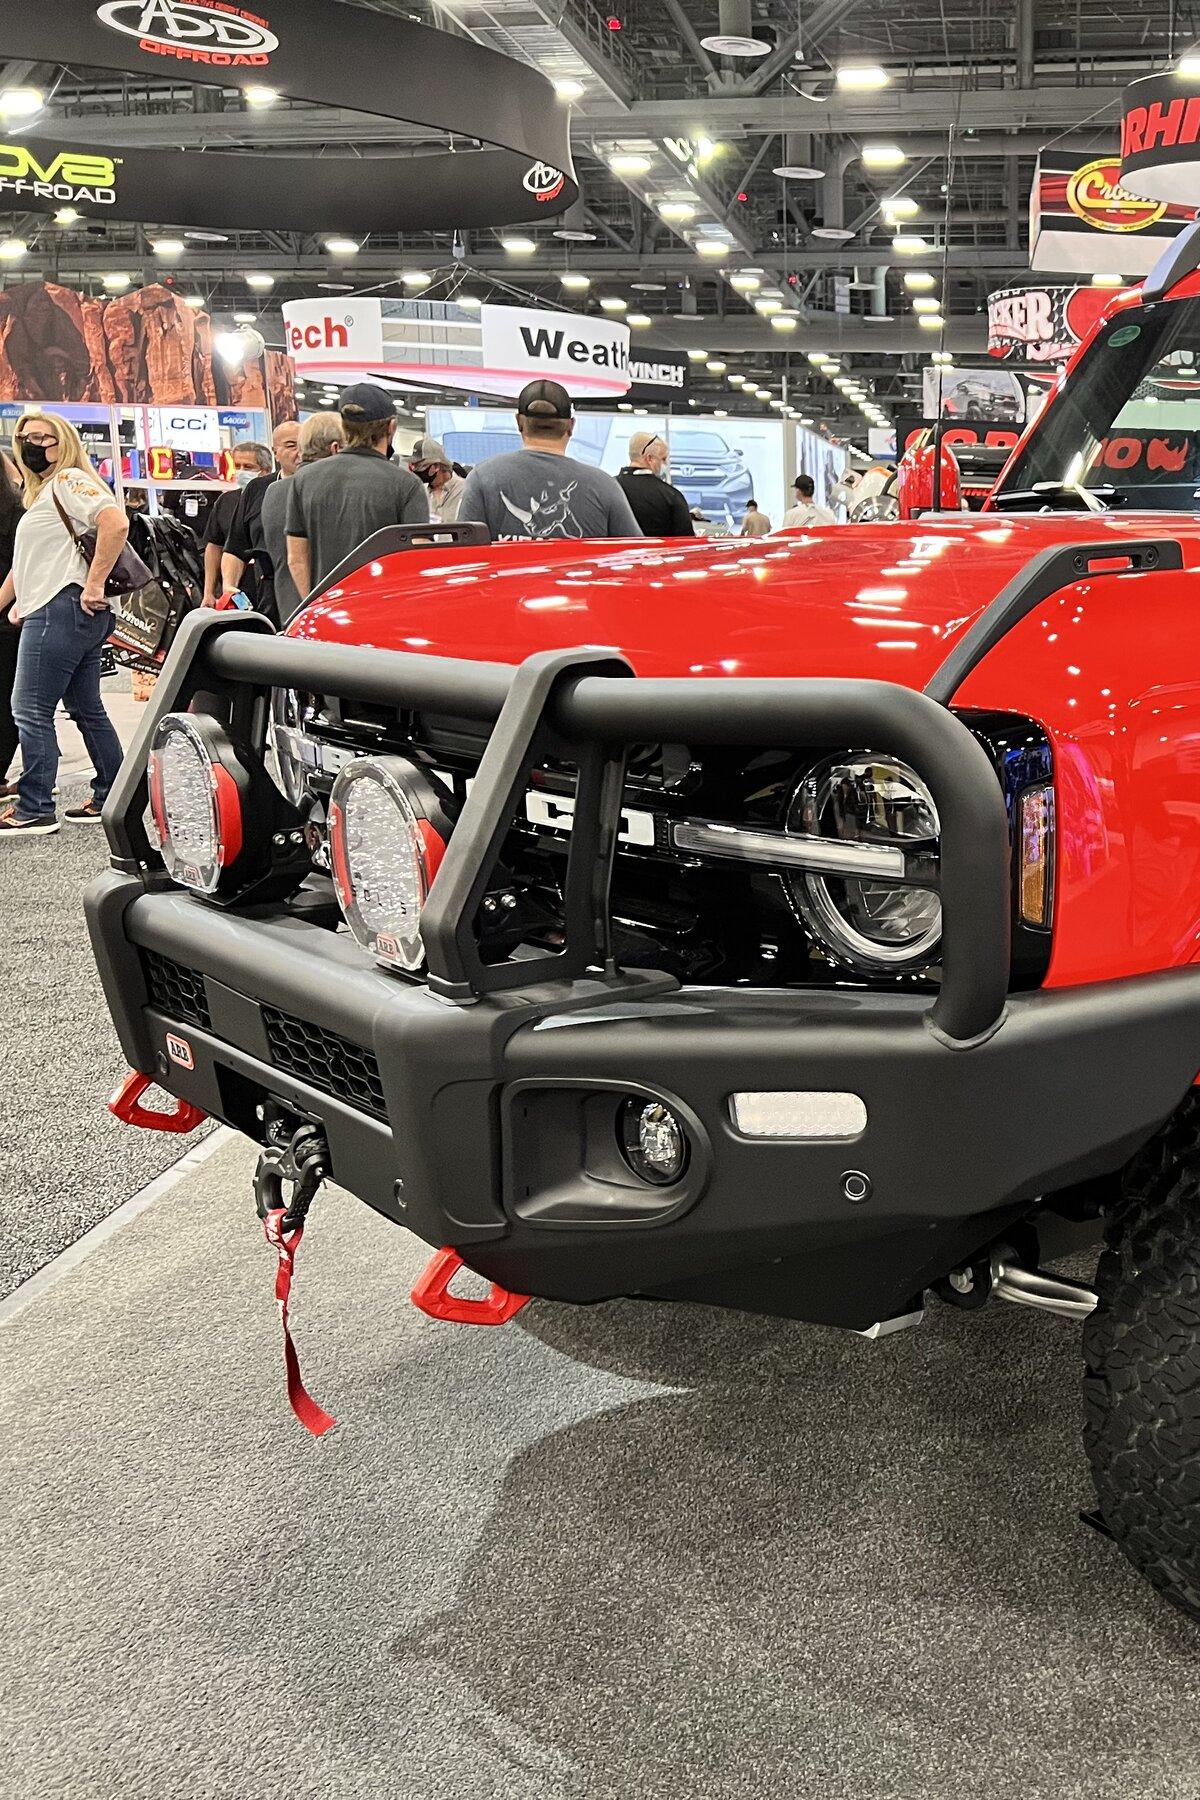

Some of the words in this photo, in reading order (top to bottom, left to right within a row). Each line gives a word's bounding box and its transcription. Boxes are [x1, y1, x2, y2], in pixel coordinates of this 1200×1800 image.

[139, 38, 270, 66] OFFROAD
[1076, 171, 1158, 209] Crow
[519, 325, 629, 371] Weath
